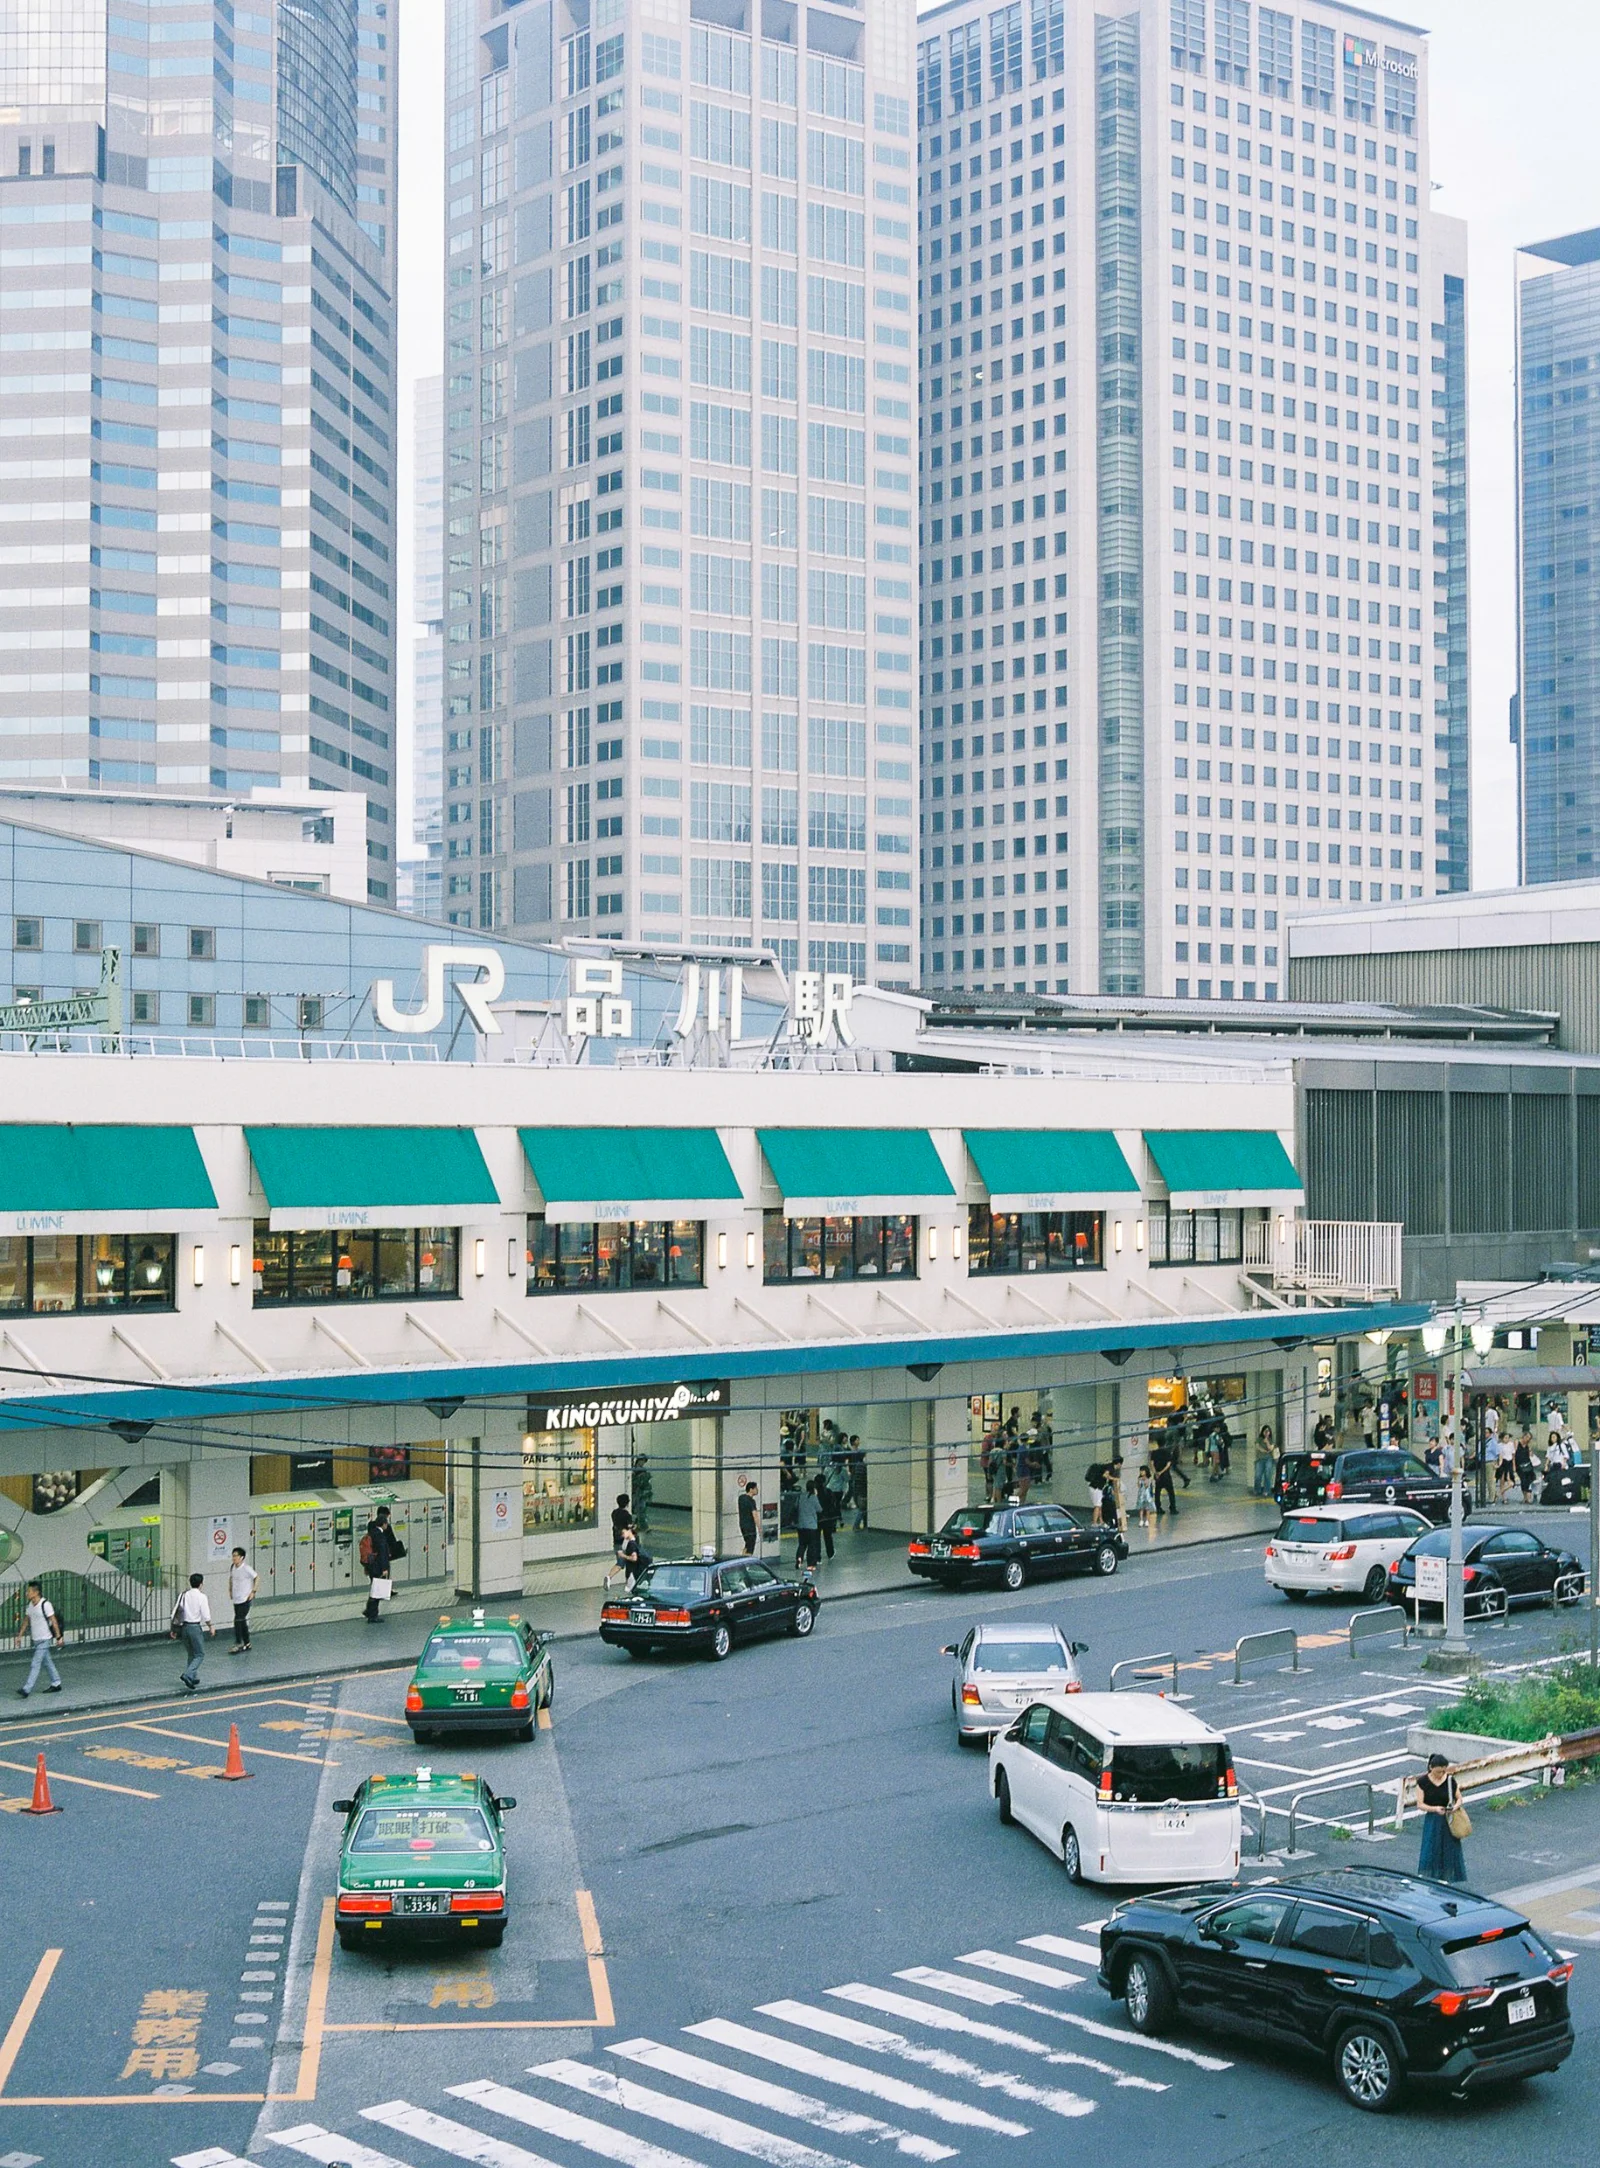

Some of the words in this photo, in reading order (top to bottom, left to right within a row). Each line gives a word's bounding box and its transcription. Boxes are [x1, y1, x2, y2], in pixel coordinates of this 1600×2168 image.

[1365, 48, 1420, 79] Microsoft
[372, 945, 505, 1035] JR
[563, 957, 857, 1049] 品川駅
[595, 1204, 631, 1218] LUMINE
[827, 1200, 859, 1213] LUMINE
[15, 1215, 65, 1231] LUMINE
[327, 1210, 370, 1226] LUMINE
[545, 1396, 680, 1430] KINOKUNIYA
[522, 1454, 548, 1465] PANE
[378, 1821, 412, 1836] 眠眠
[419, 1820, 452, 1835] 打破
[463, 1879, 476, 1889] 49
[411, 1901, 438, 1912] 33-96
[118, 1988, 210, 2082] 業務用
